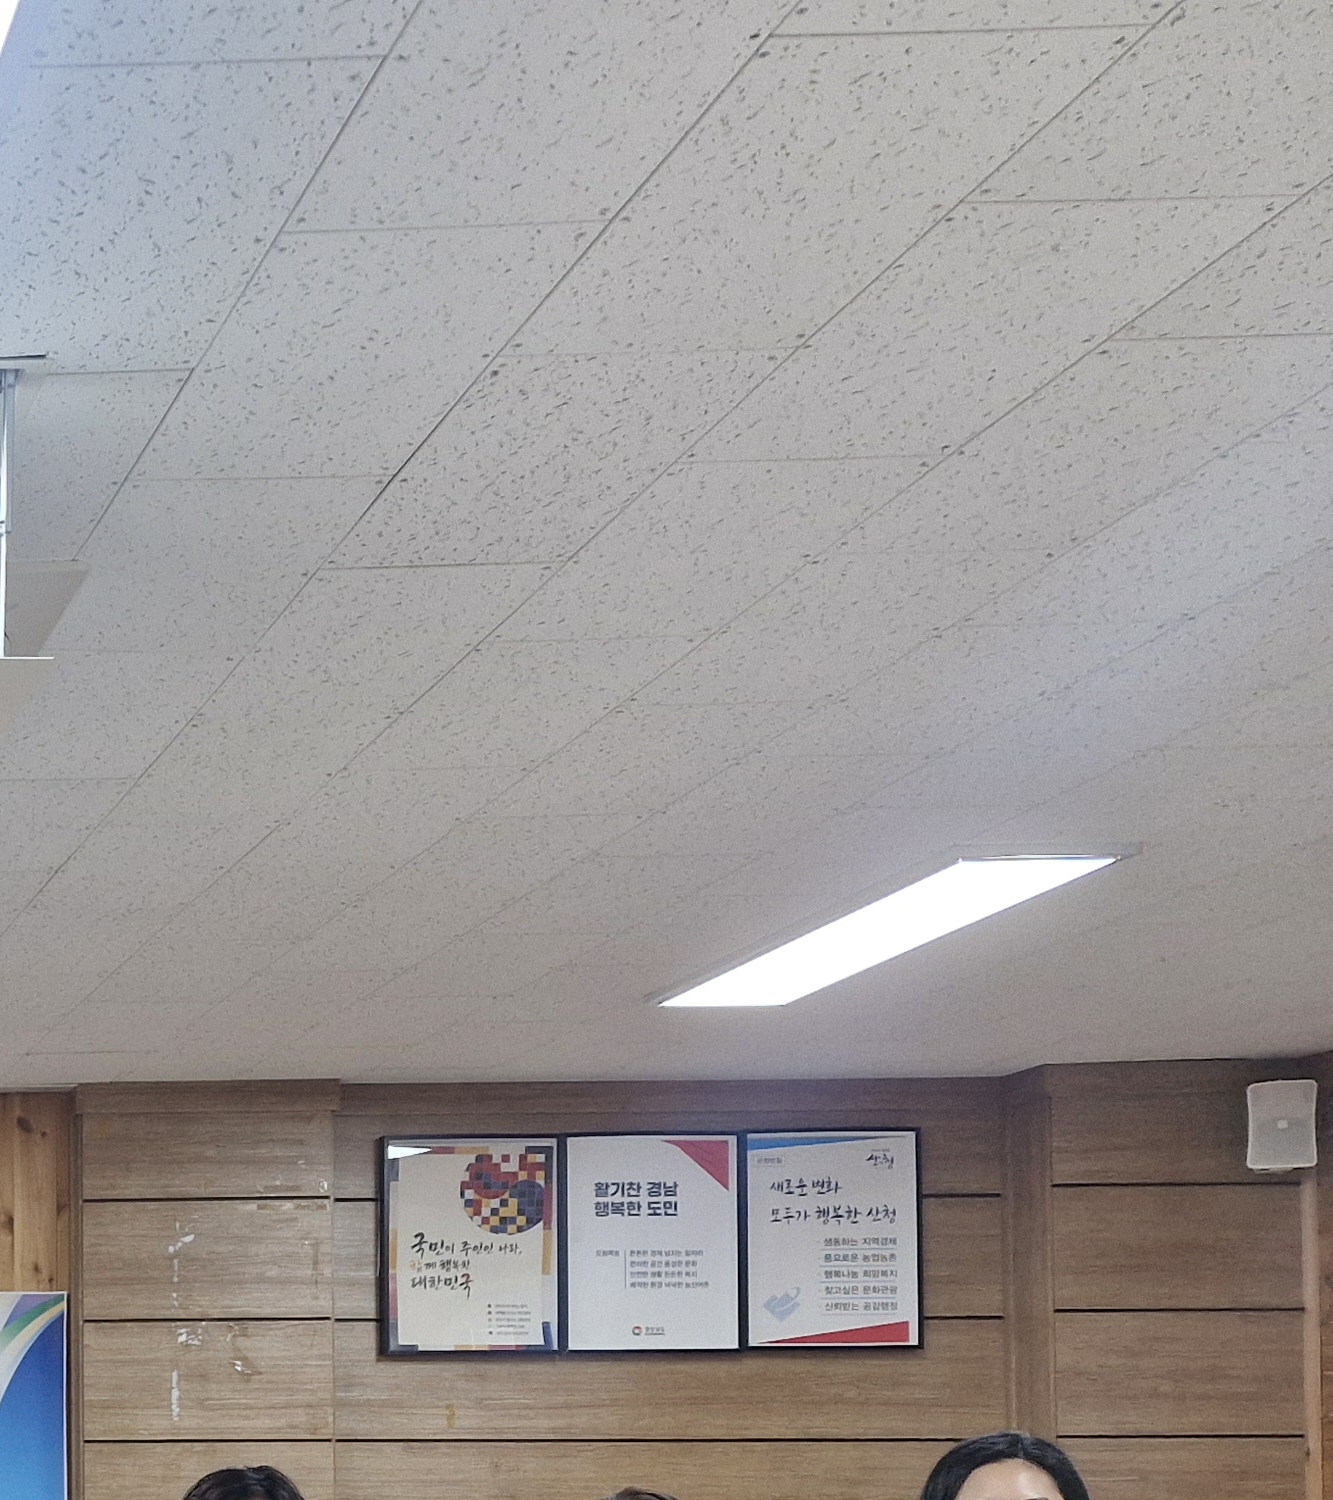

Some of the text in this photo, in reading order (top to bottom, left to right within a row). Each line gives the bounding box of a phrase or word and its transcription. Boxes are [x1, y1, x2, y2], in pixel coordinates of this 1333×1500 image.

[594, 1181, 678, 1198] 활기찬 경남
[770, 1176, 842, 1196] 새로운 변화
[594, 1200, 679, 1217] 행복한 도민
[770, 1204, 897, 1225] 모두가 행복한 산청
[410, 1231, 523, 1260] 국민이 주인인 나라,
[862, 1237, 897, 1246] 지역경제
[439, 1259, 471, 1274] 행복한
[410, 1273, 473, 1299] 대한민국
